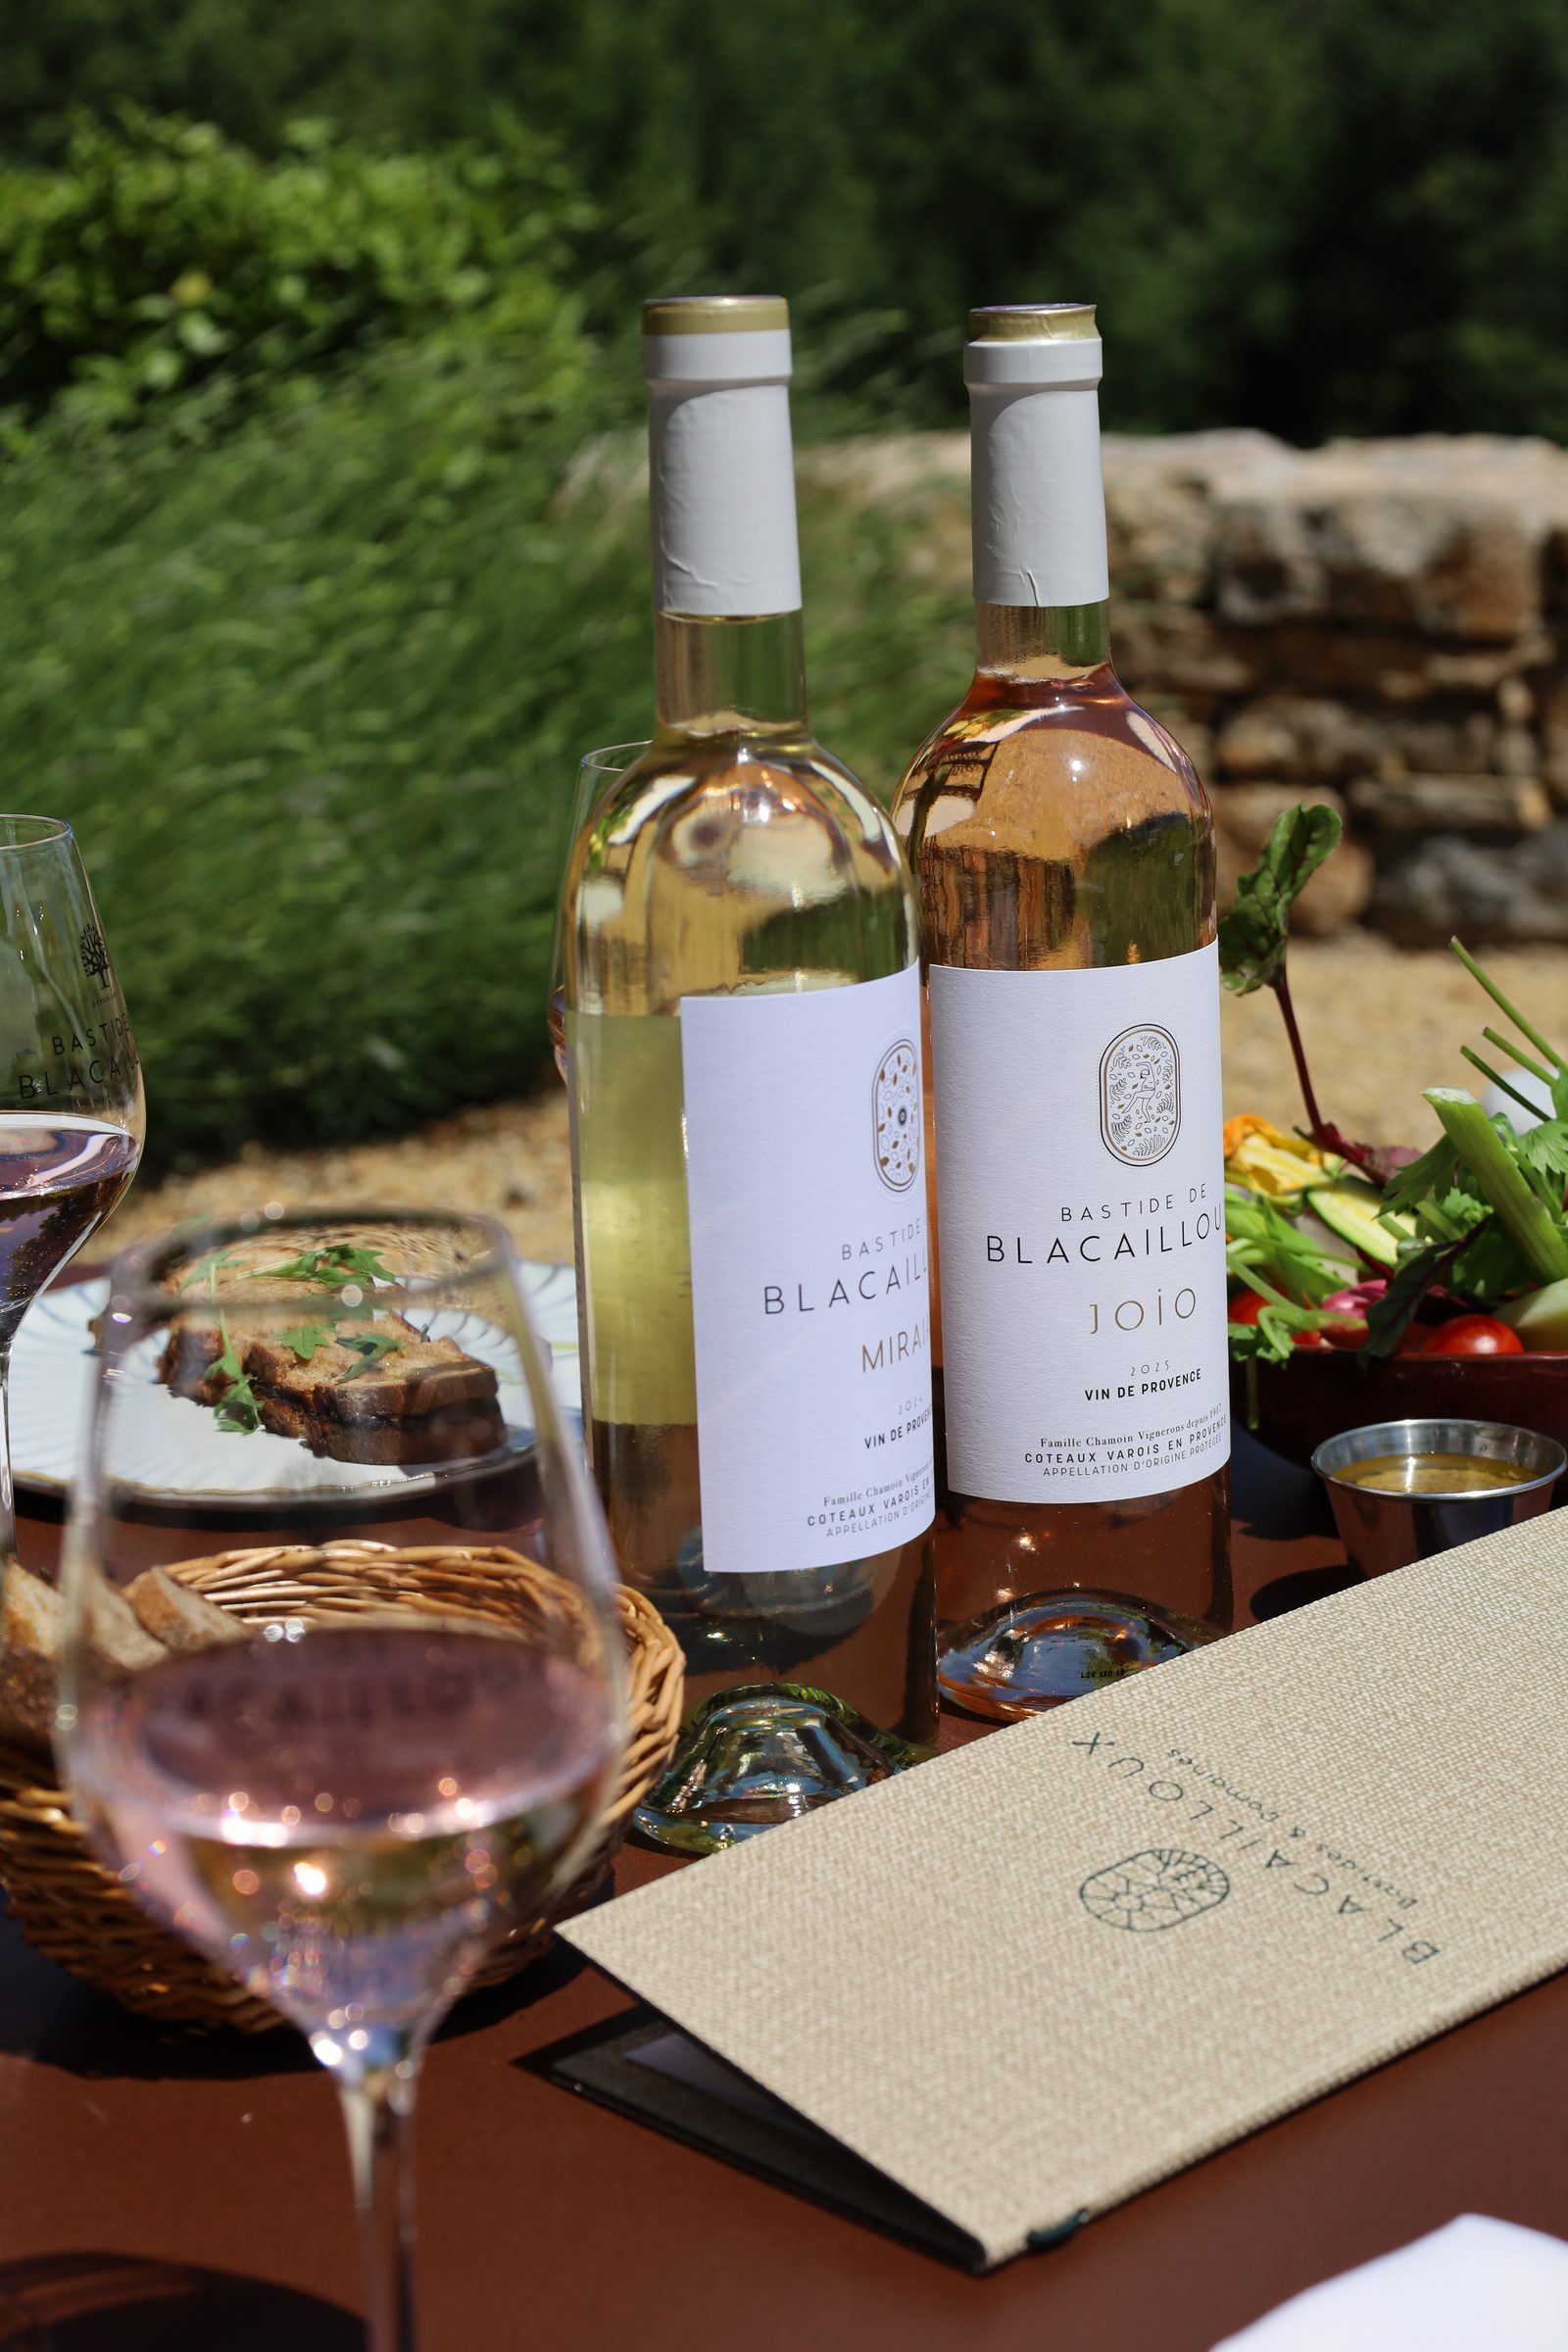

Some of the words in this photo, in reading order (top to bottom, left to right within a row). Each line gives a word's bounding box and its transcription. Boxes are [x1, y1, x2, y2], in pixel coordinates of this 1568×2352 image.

[52, 1012, 129, 1056] BASTIDE
[19, 1049, 139, 1100] BLACAIL
[1061, 1194, 1174, 1222] BASTIDE
[1189, 1183, 1206, 1203] DE
[842, 1218, 921, 1260] BASTIDE
[986, 1202, 1222, 1264] BLACAILLOU
[1085, 1388, 1110, 1401] VIN
[1117, 1385, 1135, 1398] DE
[1142, 1368, 1201, 1395] PROVENCE
[1130, 1359, 1170, 1377] 2025
[864, 1433, 885, 1449] VIN
[890, 1426, 903, 1442] DE
[1024, 1452, 1097, 1464] COTEAUX
[1107, 1444, 1159, 1461] VAROIS
[1168, 1438, 1182, 1450] EN
[1190, 1413, 1226, 1445] PROVENCE
[1040, 1437, 1082, 1448] Famille
[1086, 1434, 1133, 1446] Chamoin
[1138, 1423, 1185, 1441] Vignerons
[1186, 1413, 1208, 1429] depuis
[1043, 1463, 1128, 1477] APPELLATION
[808, 1502, 875, 1527] COTEAUX
[883, 1485, 919, 1510] VAROIS
[823, 1491, 862, 1507] Famille
[865, 1479, 903, 1498] Chamoin
[825, 1510, 900, 1538] APPELLATION
[1167, 1747, 1280, 1824] Domaines
[1072, 1732, 1440, 1964] BLACAILLOUX
[1289, 1826, 1306, 1839] &
